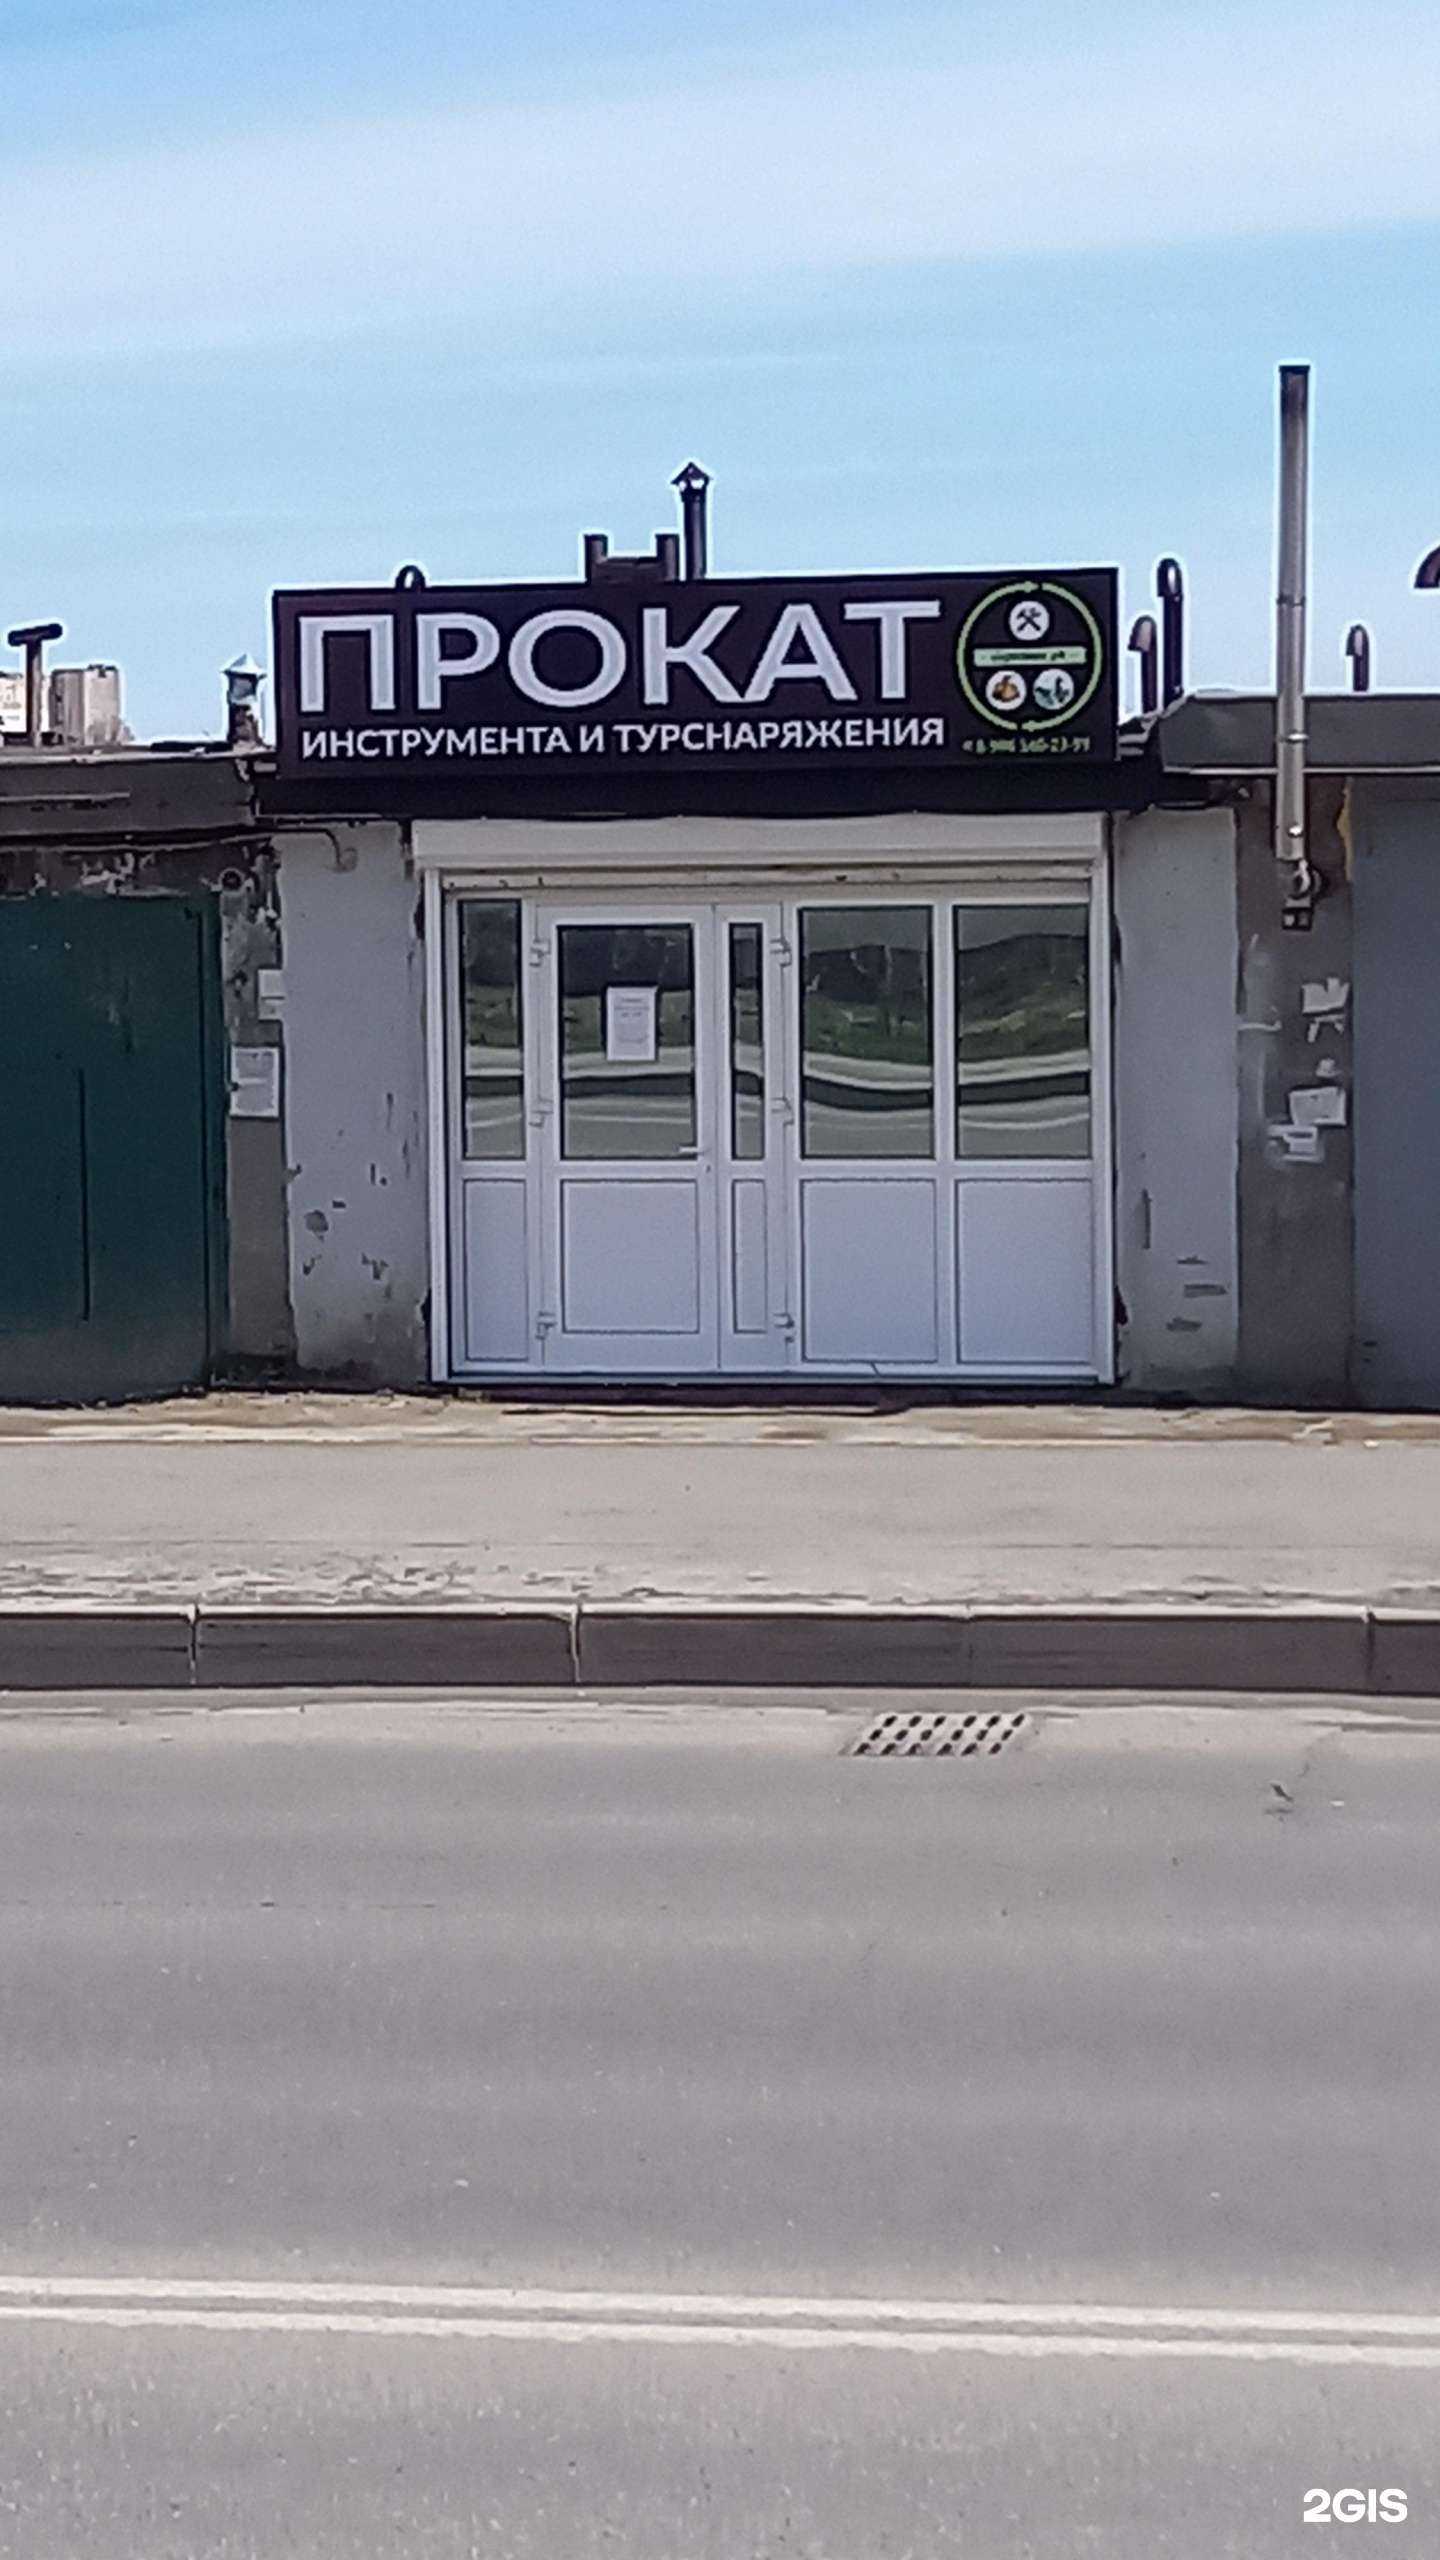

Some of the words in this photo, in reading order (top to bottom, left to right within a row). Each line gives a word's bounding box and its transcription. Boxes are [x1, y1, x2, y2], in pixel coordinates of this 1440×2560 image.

[299, 600, 942, 712] ПРОКАТ
[302, 726, 572, 760] ИНСТРУМЕНТА
[579, 725, 605, 753] И
[612, 718, 945, 753] ТУРСНАРЯЖЕНИЯ
